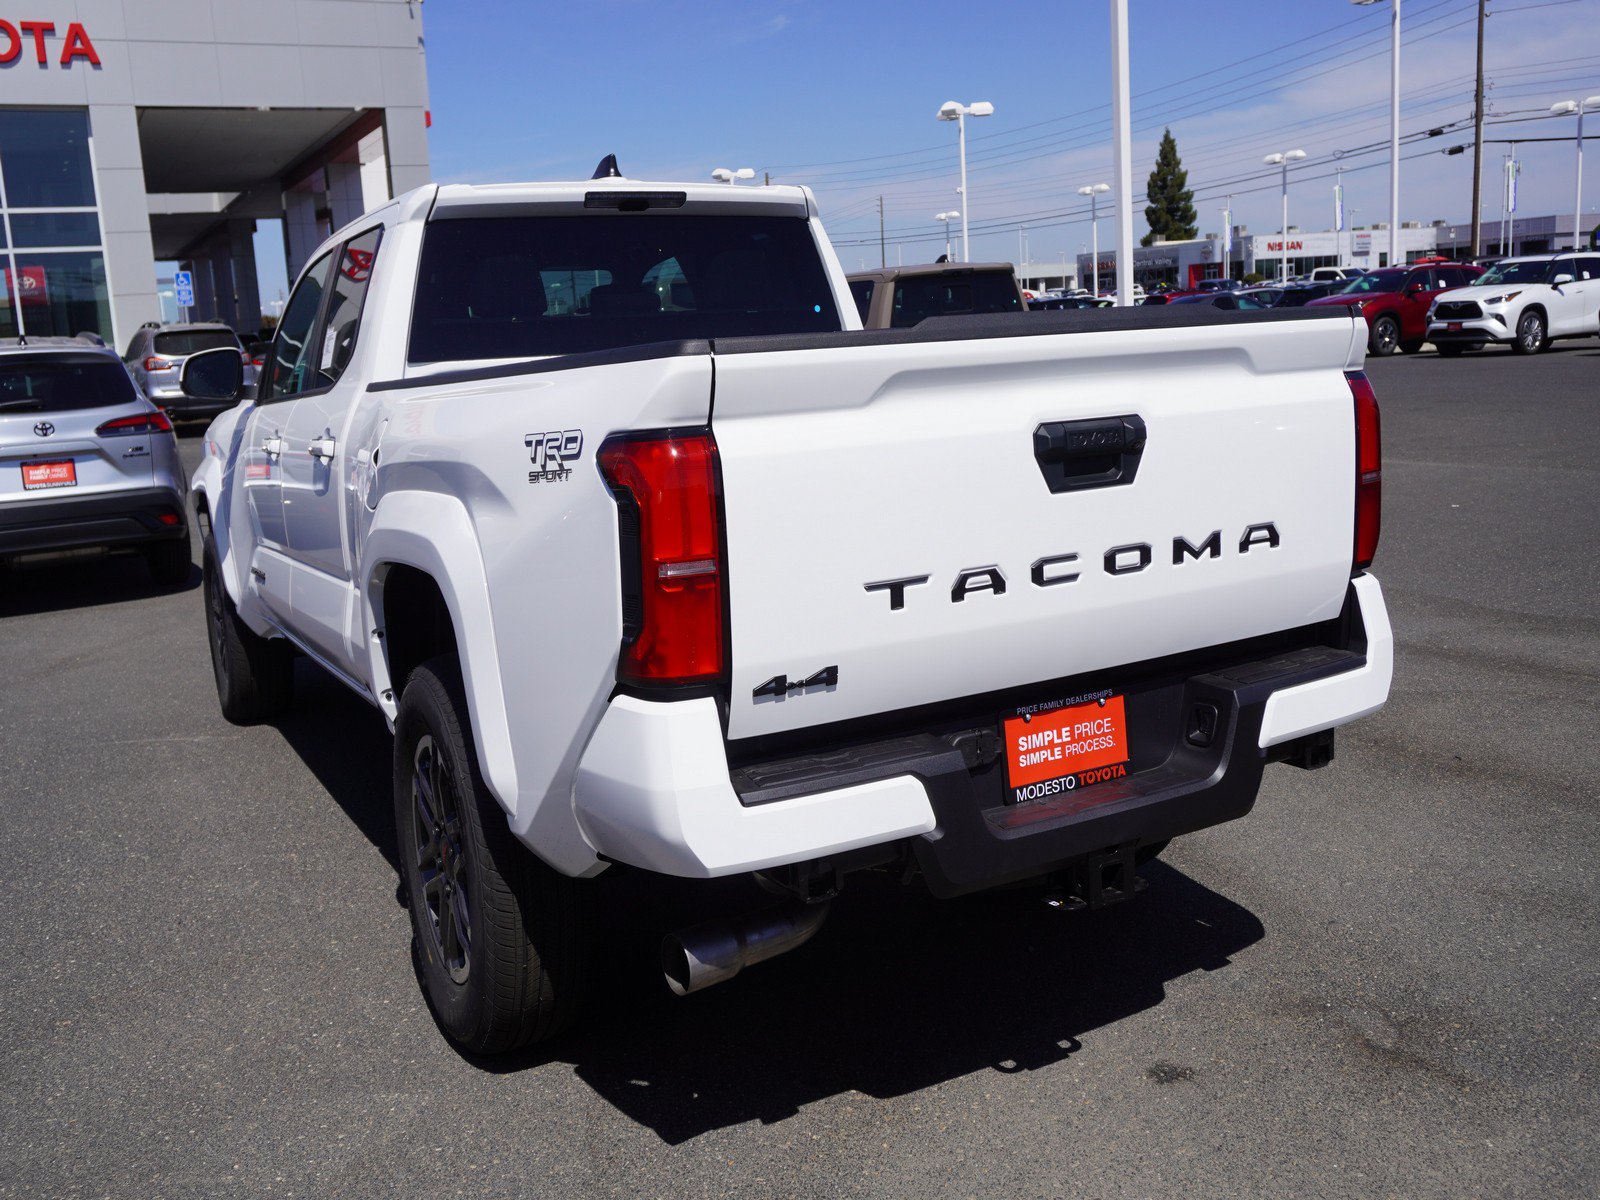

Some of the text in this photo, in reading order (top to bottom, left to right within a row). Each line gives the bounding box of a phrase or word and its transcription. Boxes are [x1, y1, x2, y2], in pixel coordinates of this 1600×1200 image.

[525, 429, 583, 470] TRD
[528, 469, 572, 483] SPORT
[863, 521, 1281, 611] TACOMA
[1016, 689, 1113, 715] PRICE FAMILY DEALERSHIPS
[1018, 717, 1115, 751] SIMPLE PRICE.
[1019, 735, 1116, 767] SIMPLE PROCESS.
[1016, 764, 1126, 802] MODESTO TOYOTA
